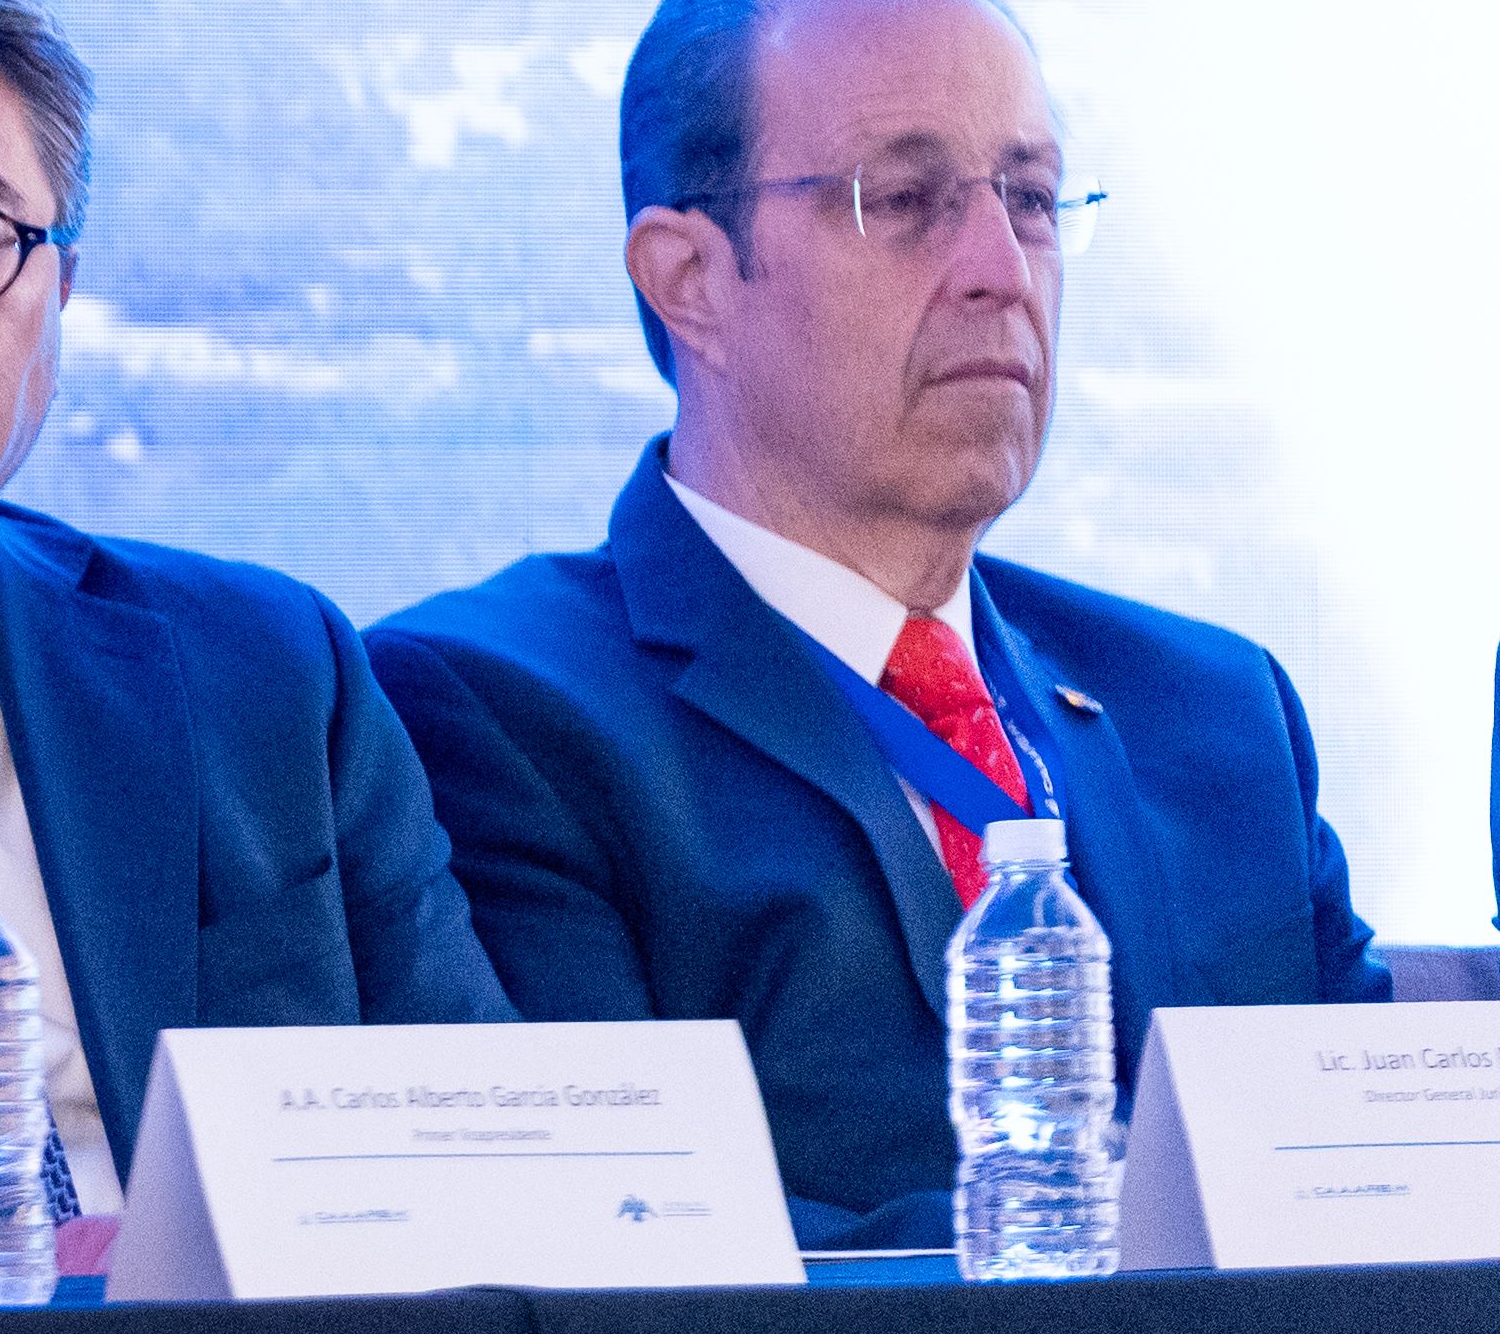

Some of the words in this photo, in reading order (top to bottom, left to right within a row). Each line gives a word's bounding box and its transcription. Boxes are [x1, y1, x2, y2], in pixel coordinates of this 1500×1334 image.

[1316, 1049, 1356, 1072] Lic.
[1362, 1048, 1415, 1071] Juan
[1420, 1046, 1493, 1069] Carlos
[331, 1085, 400, 1109] Carlos
[406, 1085, 486, 1108] Alberto
[563, 1082, 663, 1106] González
